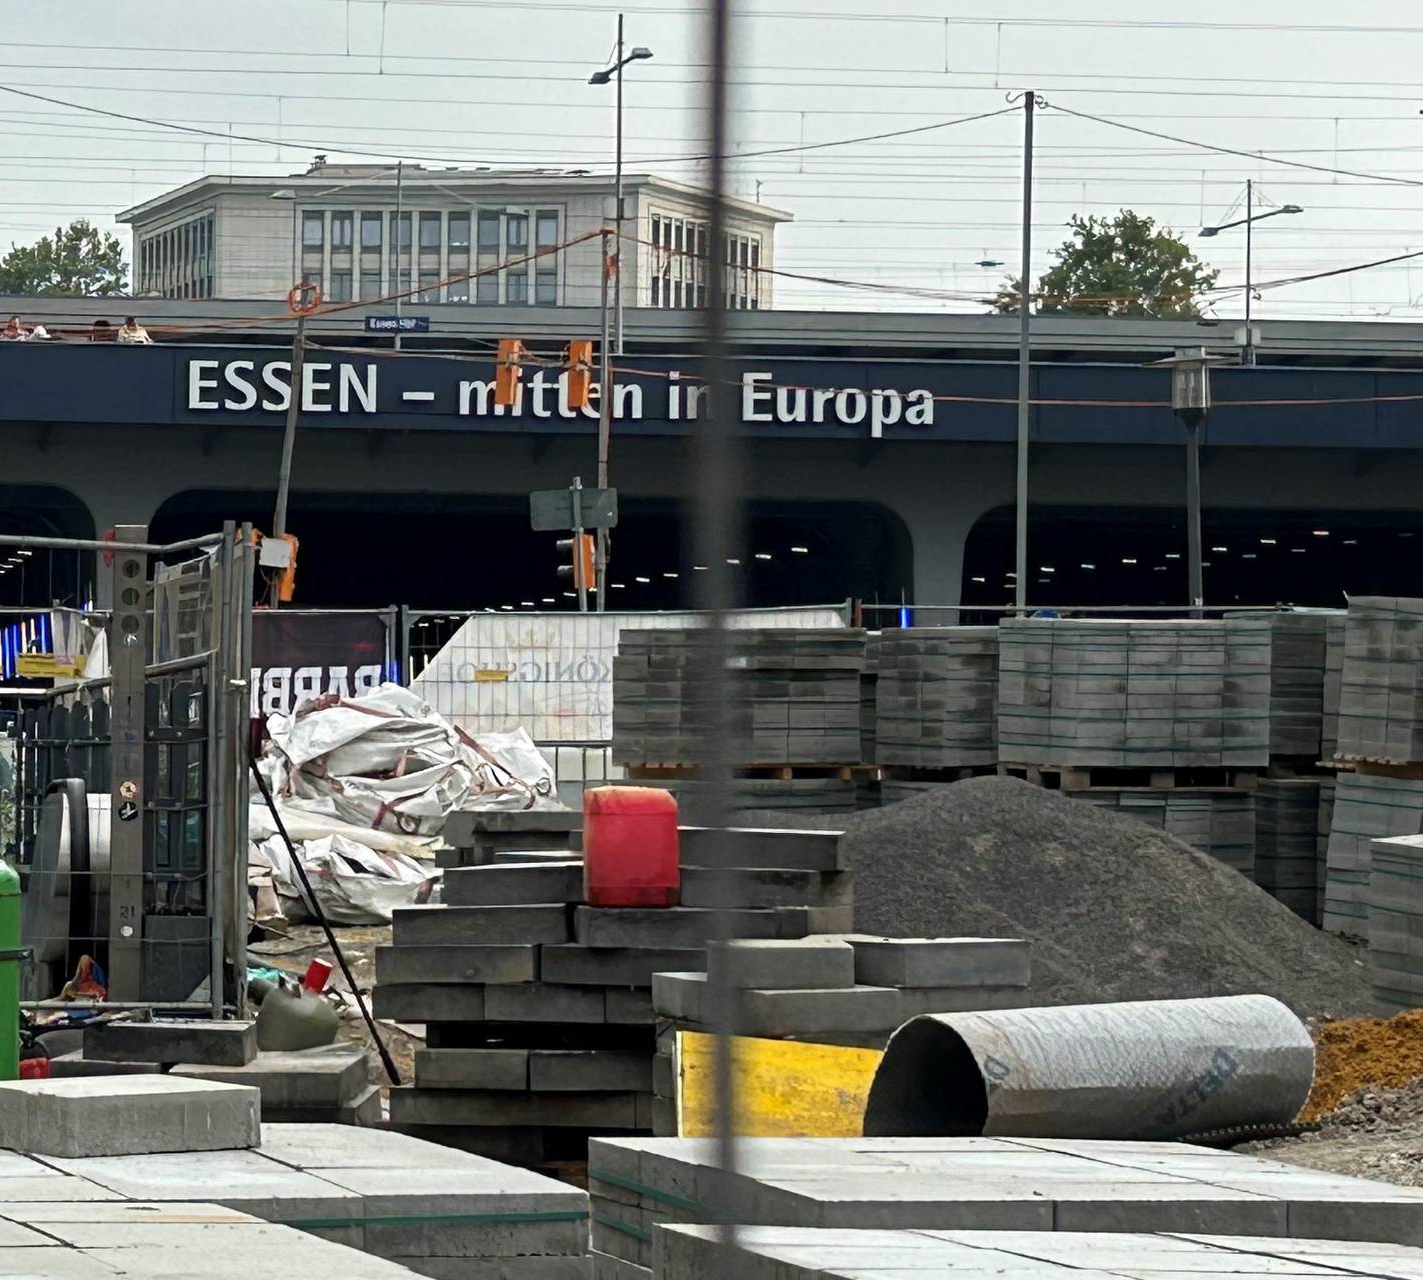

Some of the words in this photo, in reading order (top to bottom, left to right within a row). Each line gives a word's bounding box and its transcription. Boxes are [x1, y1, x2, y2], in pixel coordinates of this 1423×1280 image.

[188, 360, 377, 413] ESSEN
[459, 366, 643, 419] mitten
[742, 372, 934, 437] Europa
